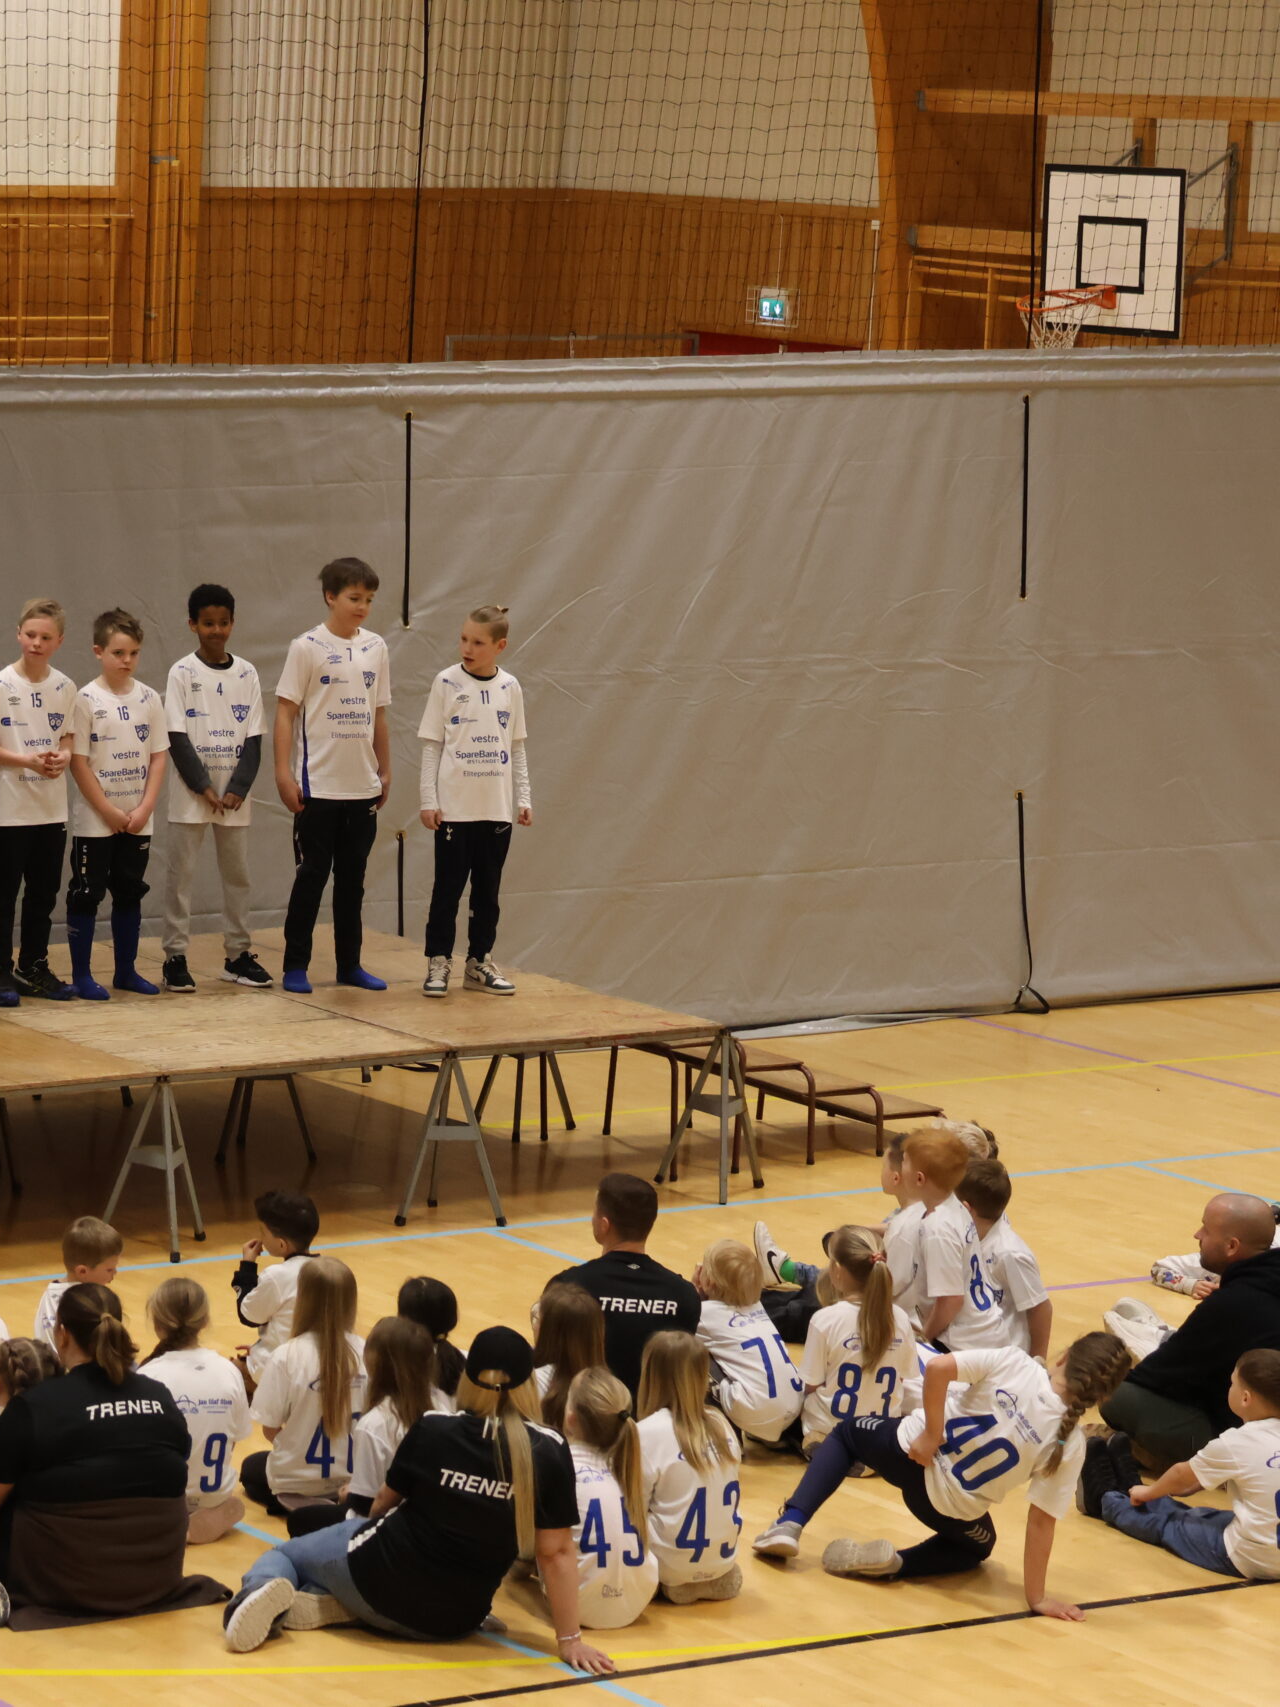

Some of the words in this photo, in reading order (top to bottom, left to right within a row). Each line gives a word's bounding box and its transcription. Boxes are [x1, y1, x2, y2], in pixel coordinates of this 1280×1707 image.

[217, 682, 223, 696] 4
[31, 693, 42, 708] 15
[340, 696, 366, 705] vestre
[480, 690, 490, 705] 11
[117, 706, 129, 720] 16
[208, 729, 235, 737] vestre
[471, 734, 499, 743] vestre
[24, 738, 52, 746] vestre
[112, 751, 140, 759] vestre
[455, 750, 499, 760] SpareBank
[99, 767, 140, 779] SpareBank
[599, 1297, 678, 1315] TRENER
[831, 1363, 896, 1419] 83
[86, 1400, 164, 1420] TRENER
[939, 1414, 1019, 1490] 40
[200, 1433, 228, 1492] 9
[676, 1480, 742, 1563] 43
[580, 1496, 644, 1568] 45
